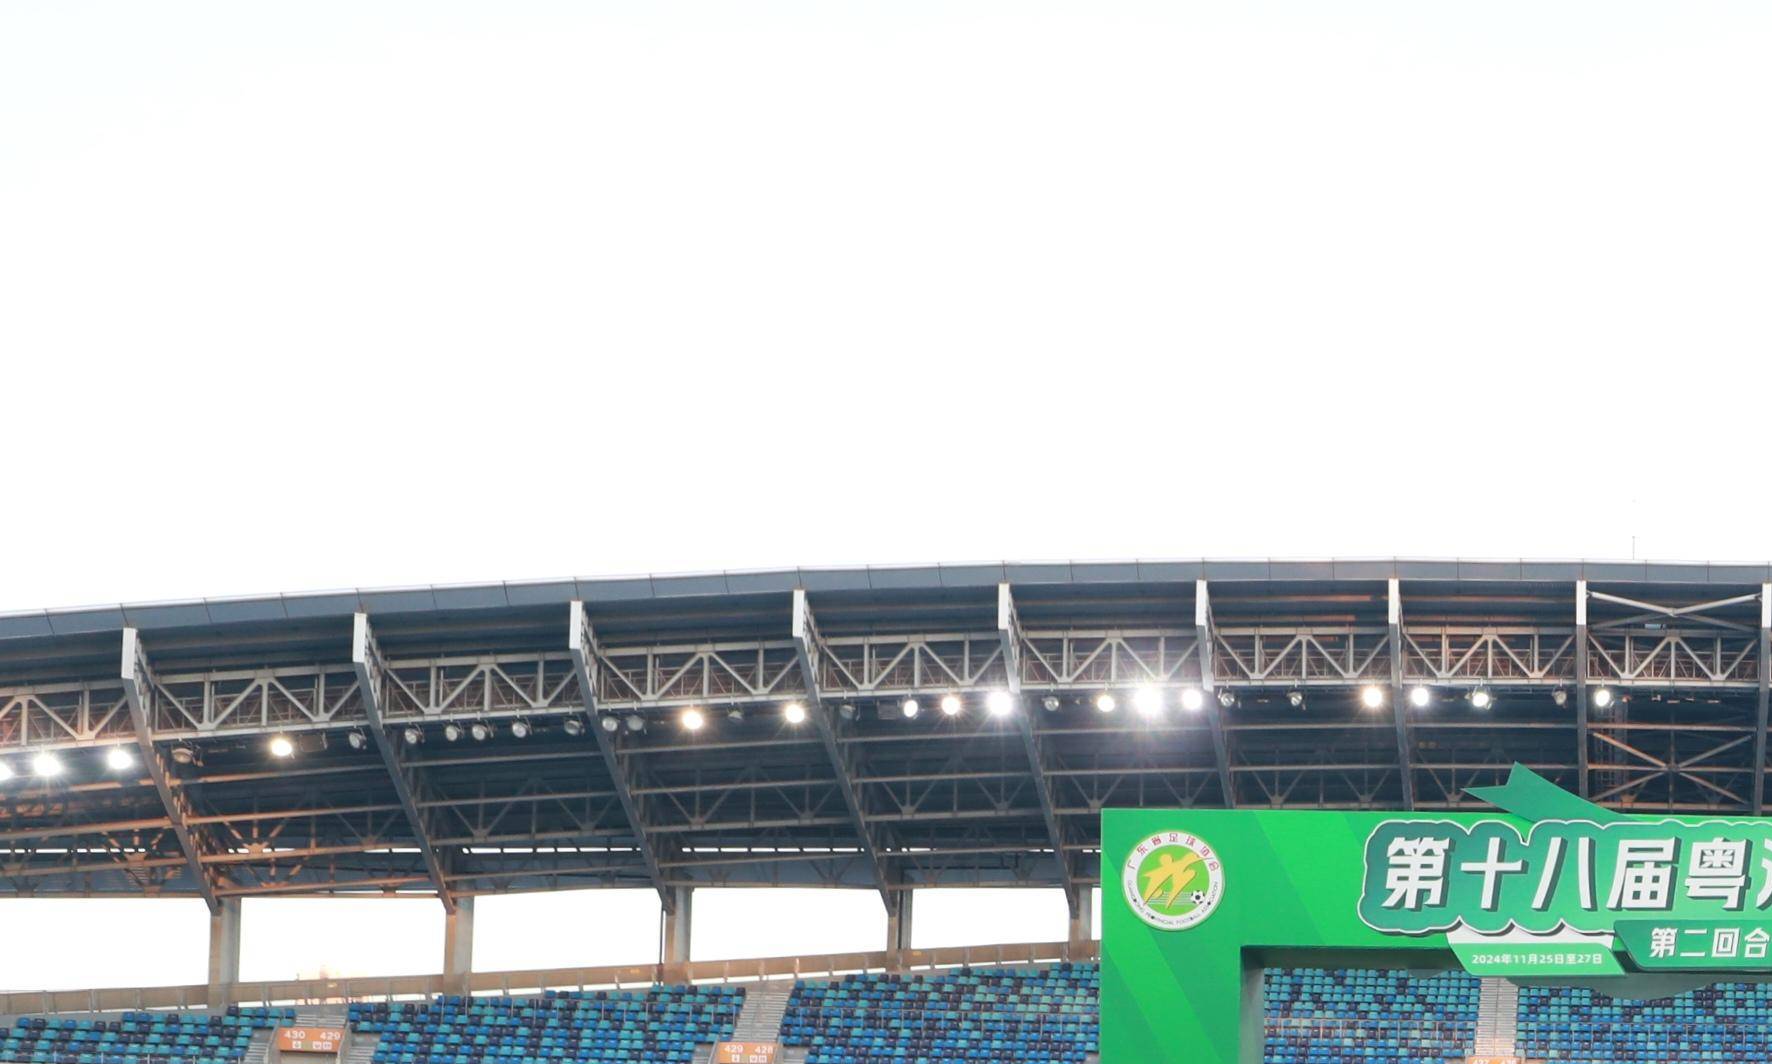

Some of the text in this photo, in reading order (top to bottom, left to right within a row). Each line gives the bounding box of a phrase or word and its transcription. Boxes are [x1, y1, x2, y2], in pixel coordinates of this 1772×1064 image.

[1471, 953, 1603, 965] 2024年11月25日至27日
[284, 1030, 305, 1039] 430
